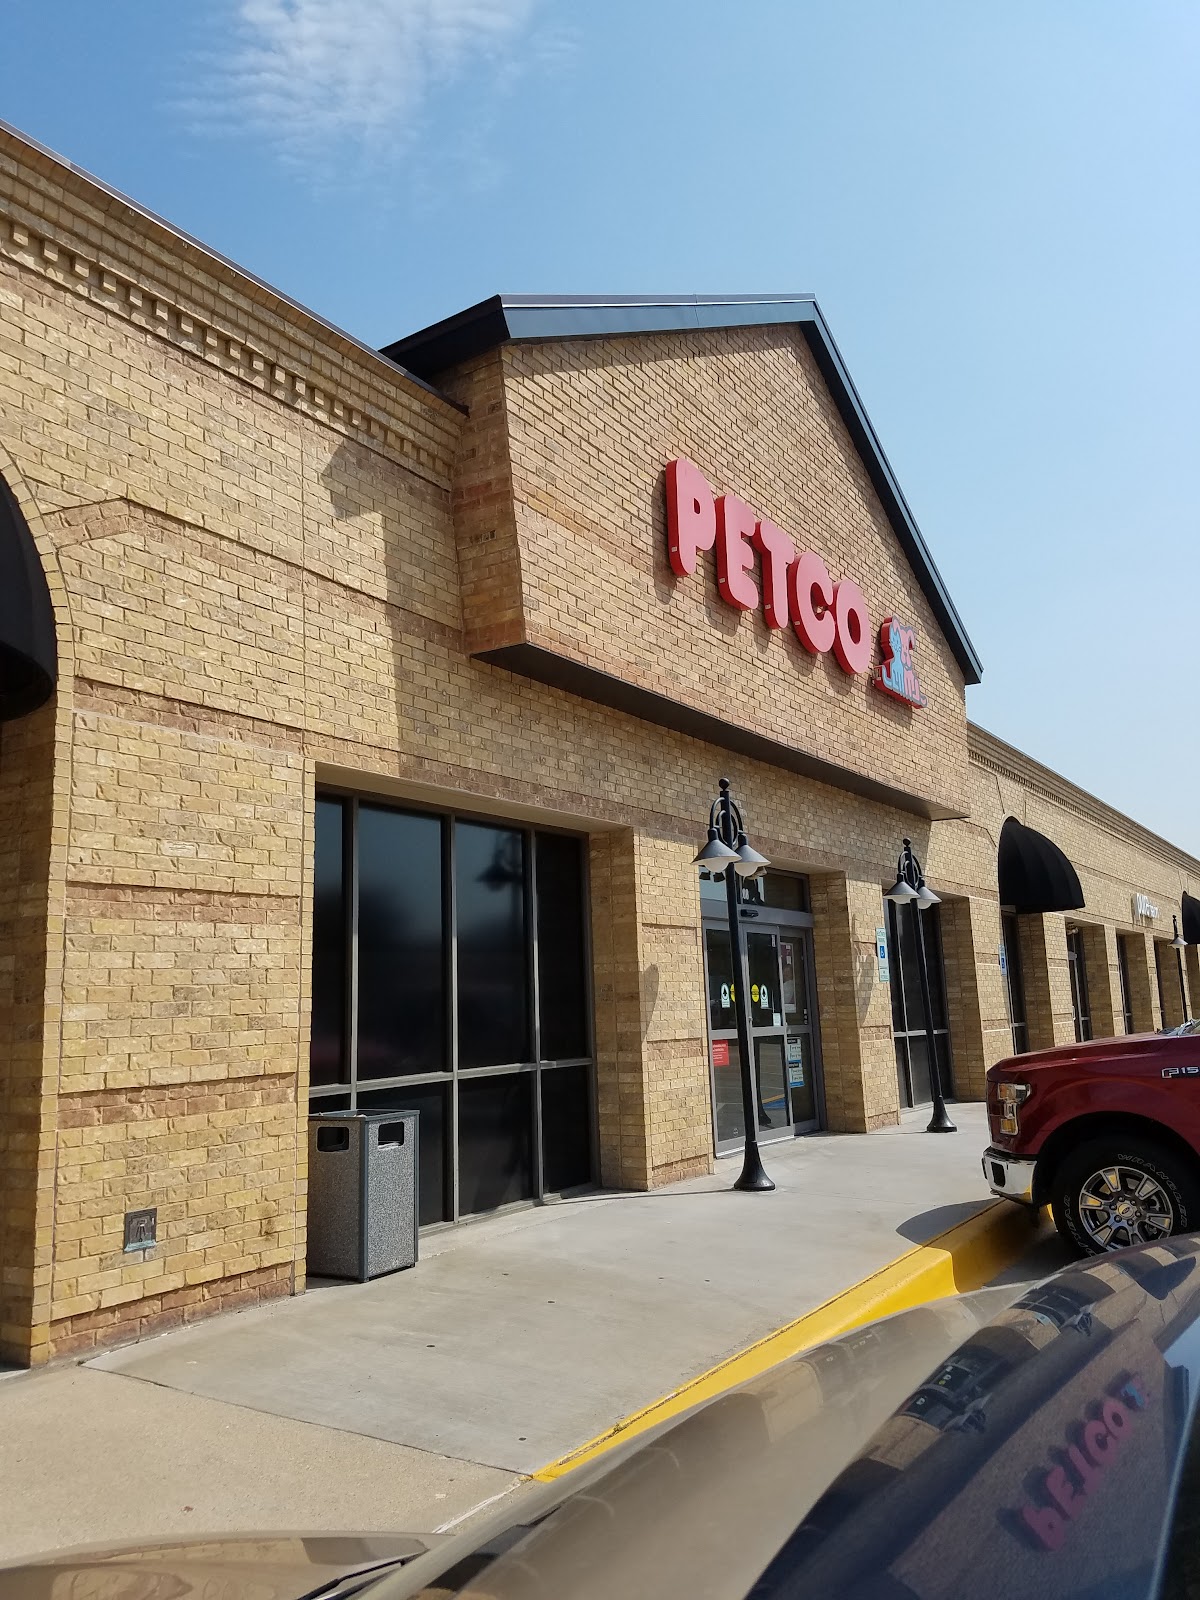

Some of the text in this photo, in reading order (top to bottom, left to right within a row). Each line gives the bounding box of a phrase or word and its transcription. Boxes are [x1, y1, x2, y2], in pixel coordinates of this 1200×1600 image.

[665, 457, 871, 674] PETCO
[1161, 1066, 1200, 1079] F15
[1117, 1153, 1188, 1228] WRANGLER
